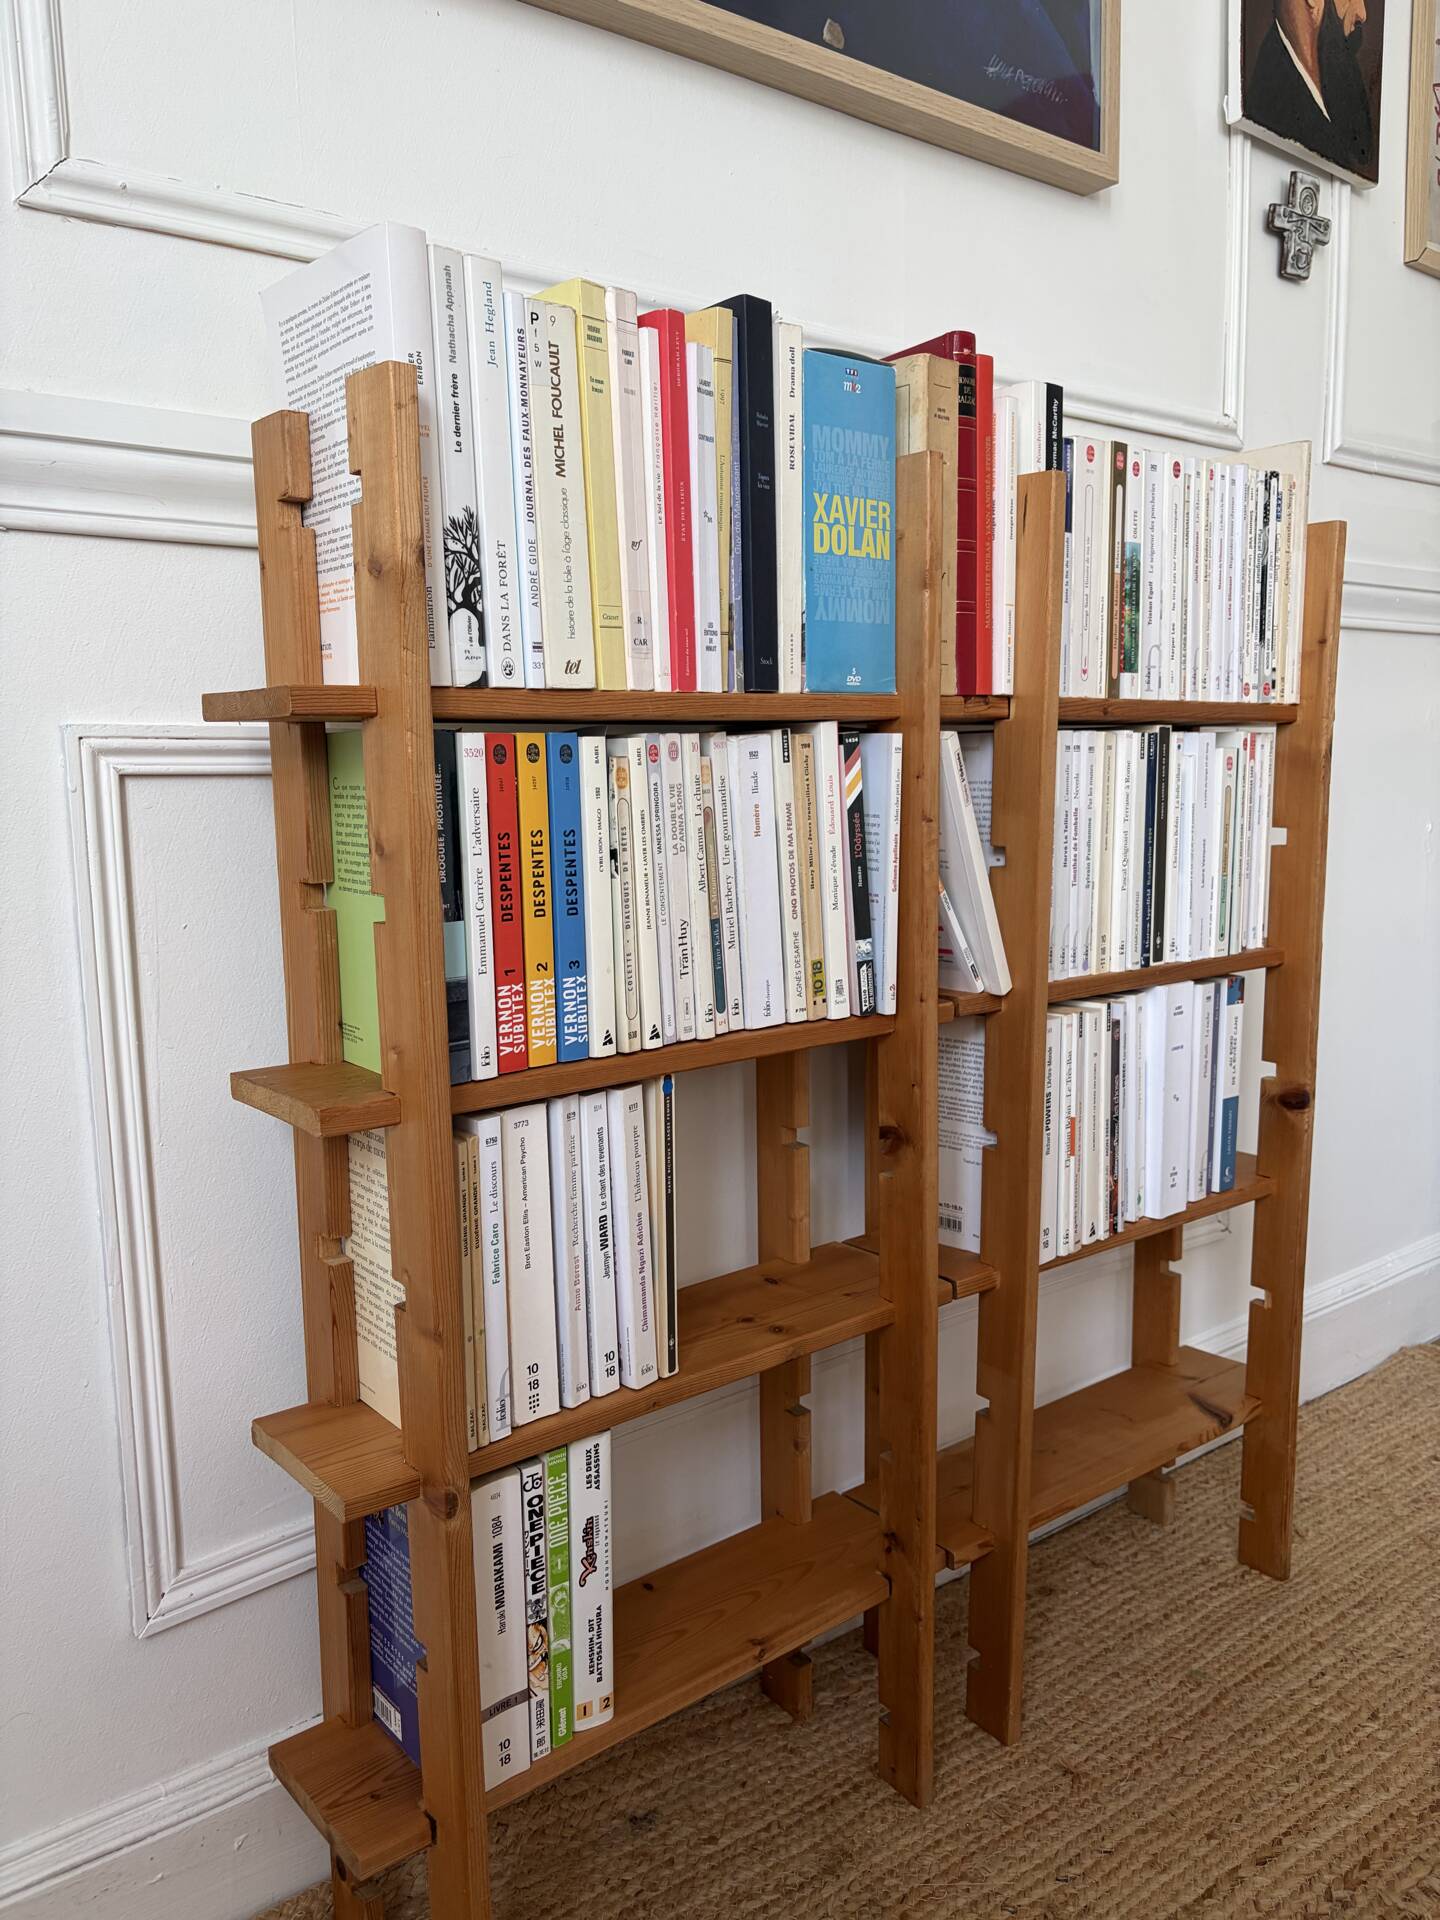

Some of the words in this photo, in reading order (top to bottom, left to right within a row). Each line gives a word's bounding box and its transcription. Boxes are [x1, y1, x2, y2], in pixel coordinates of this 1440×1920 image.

[443, 264, 455, 311] Appanah
[483, 281, 495, 333] Hegland
[447, 314, 457, 364] Nathacha
[487, 340, 499, 368] Jean
[788, 346, 796, 365] doll
[416, 351, 424, 385] ERIBON
[517, 328, 530, 442] FAUX-MONNAYEURS
[548, 340, 563, 419] FOUCAULT
[788, 367, 797, 398] Drama
[450, 373, 459, 399] frère
[450, 402, 461, 438] dernier
[788, 414, 797, 441] VIDAL
[1051, 398, 1059, 439] McCarthy
[455, 441, 462, 453] Le
[522, 446, 532, 468] DES
[552, 423, 566, 478] MICHEL
[788, 445, 797, 471] ROSE
[812, 424, 889, 461] MOMMY
[521, 473, 535, 524] JOURNAL
[560, 488, 569, 530] classique
[813, 491, 890, 530] XAVIER
[527, 538, 537, 566] GIDE
[813, 522, 890, 560] DOLAN
[497, 540, 508, 588] FORÊT
[500, 592, 509, 611] LA
[527, 570, 539, 608] ANDRÉ
[565, 611, 575, 640] histoire
[814, 597, 890, 624] MOMMY
[503, 615, 512, 652] DANS
[463, 747, 484, 759] 3520
[652, 782, 660, 822] SPRINGORA
[693, 774, 701, 800] chute
[826, 775, 834, 798] Louis
[471, 787, 483, 856] L'adversaire
[670, 804, 678, 840] DOUBLE
[694, 800, 702, 817] La
[718, 775, 731, 840] gourmandise
[785, 802, 793, 831] FEMME
[620, 826, 628, 852] BÊTES
[654, 823, 662, 855] VANESSA
[671, 842, 679, 856] LA
[678, 813, 686, 853] D'ANNA
[695, 826, 705, 861] Camus
[787, 833, 794, 847] MA
[852, 812, 863, 858] L'Odyssée
[622, 861, 629, 872] DE
[721, 844, 731, 866] Une
[788, 849, 794, 860] DE
[830, 845, 838, 873] s'évade
[475, 867, 485, 911] Carrère
[497, 831, 514, 922] DESPENTES
[530, 829, 547, 918] DESPENTES
[563, 829, 579, 916] DESPENTES
[658, 862, 666, 916] CONSENTEMENT
[697, 860, 706, 893] Albert
[624, 881, 632, 930] DIALOGUES
[722, 874, 733, 914] Barbery
[831, 875, 840, 911] Monique
[477, 914, 488, 975] Emmanuel
[678, 918, 689, 948] Huy
[726, 917, 736, 950] Muriel
[792, 931, 801, 968] DESARTHE
[504, 968, 516, 977] 1
[536, 962, 549, 972] 2
[569, 959, 580, 970] 3
[626, 952, 634, 992] COLETTE
[812, 960, 822, 977] 18
[795, 970, 803, 998] AGNÈS
[813, 979, 823, 996] 10
[497, 984, 514, 1056] VERNON
[512, 983, 526, 1054] SUBUTEX
[530, 979, 547, 1049] VERNON
[543, 978, 557, 1047] SUBUTEX
[562, 976, 578, 1046] VERNON
[576, 975, 588, 1043] SUBUTEX
[480, 1045, 491, 1067] folio
[519, 1137, 527, 1165] Psycho
[596, 1126, 605, 1163] revenants
[632, 1124, 641, 1158] pourpre
[489, 1160, 498, 1199] discours
[520, 1165, 528, 1201] American
[597, 1163, 605, 1177] des
[633, 1160, 642, 1202] L'hibiscus
[598, 1178, 606, 1199] chant
[490, 1200, 499, 1214] Le
[570, 1201, 580, 1247] Recherche
[490, 1223, 499, 1246] Caro
[598, 1214, 609, 1251] WARD
[635, 1211, 644, 1246] Adichie
[491, 1248, 500, 1285] Fabrice
[602, 1250, 611, 1280] Jesmyn
[638, 1248, 646, 1274] Ngozi
[640, 1275, 649, 1333] Chimamanda
[526, 1362, 539, 1376] 10
[605, 1350, 615, 1362] 10
[605, 1365, 615, 1378] 18
[527, 1378, 540, 1392] 18
[496, 1399, 506, 1421] folio
[547, 1472, 567, 1517] PIECE
[491, 1515, 503, 1539] 1Q84
[548, 1517, 568, 1548] ONE
[492, 1542, 505, 1611] MURAKAMI
[497, 1609, 507, 1636] Haruki
[595, 1604, 603, 1640] HIMURA
[588, 1633, 596, 1675] KENSHIN,
[595, 1640, 603, 1683] BATTOSAÏ
[489, 1699, 512, 1717] LIVRE
[602, 1697, 611, 1709] 2
[498, 1738, 511, 1752] 10
[499, 1753, 511, 1767] 18
